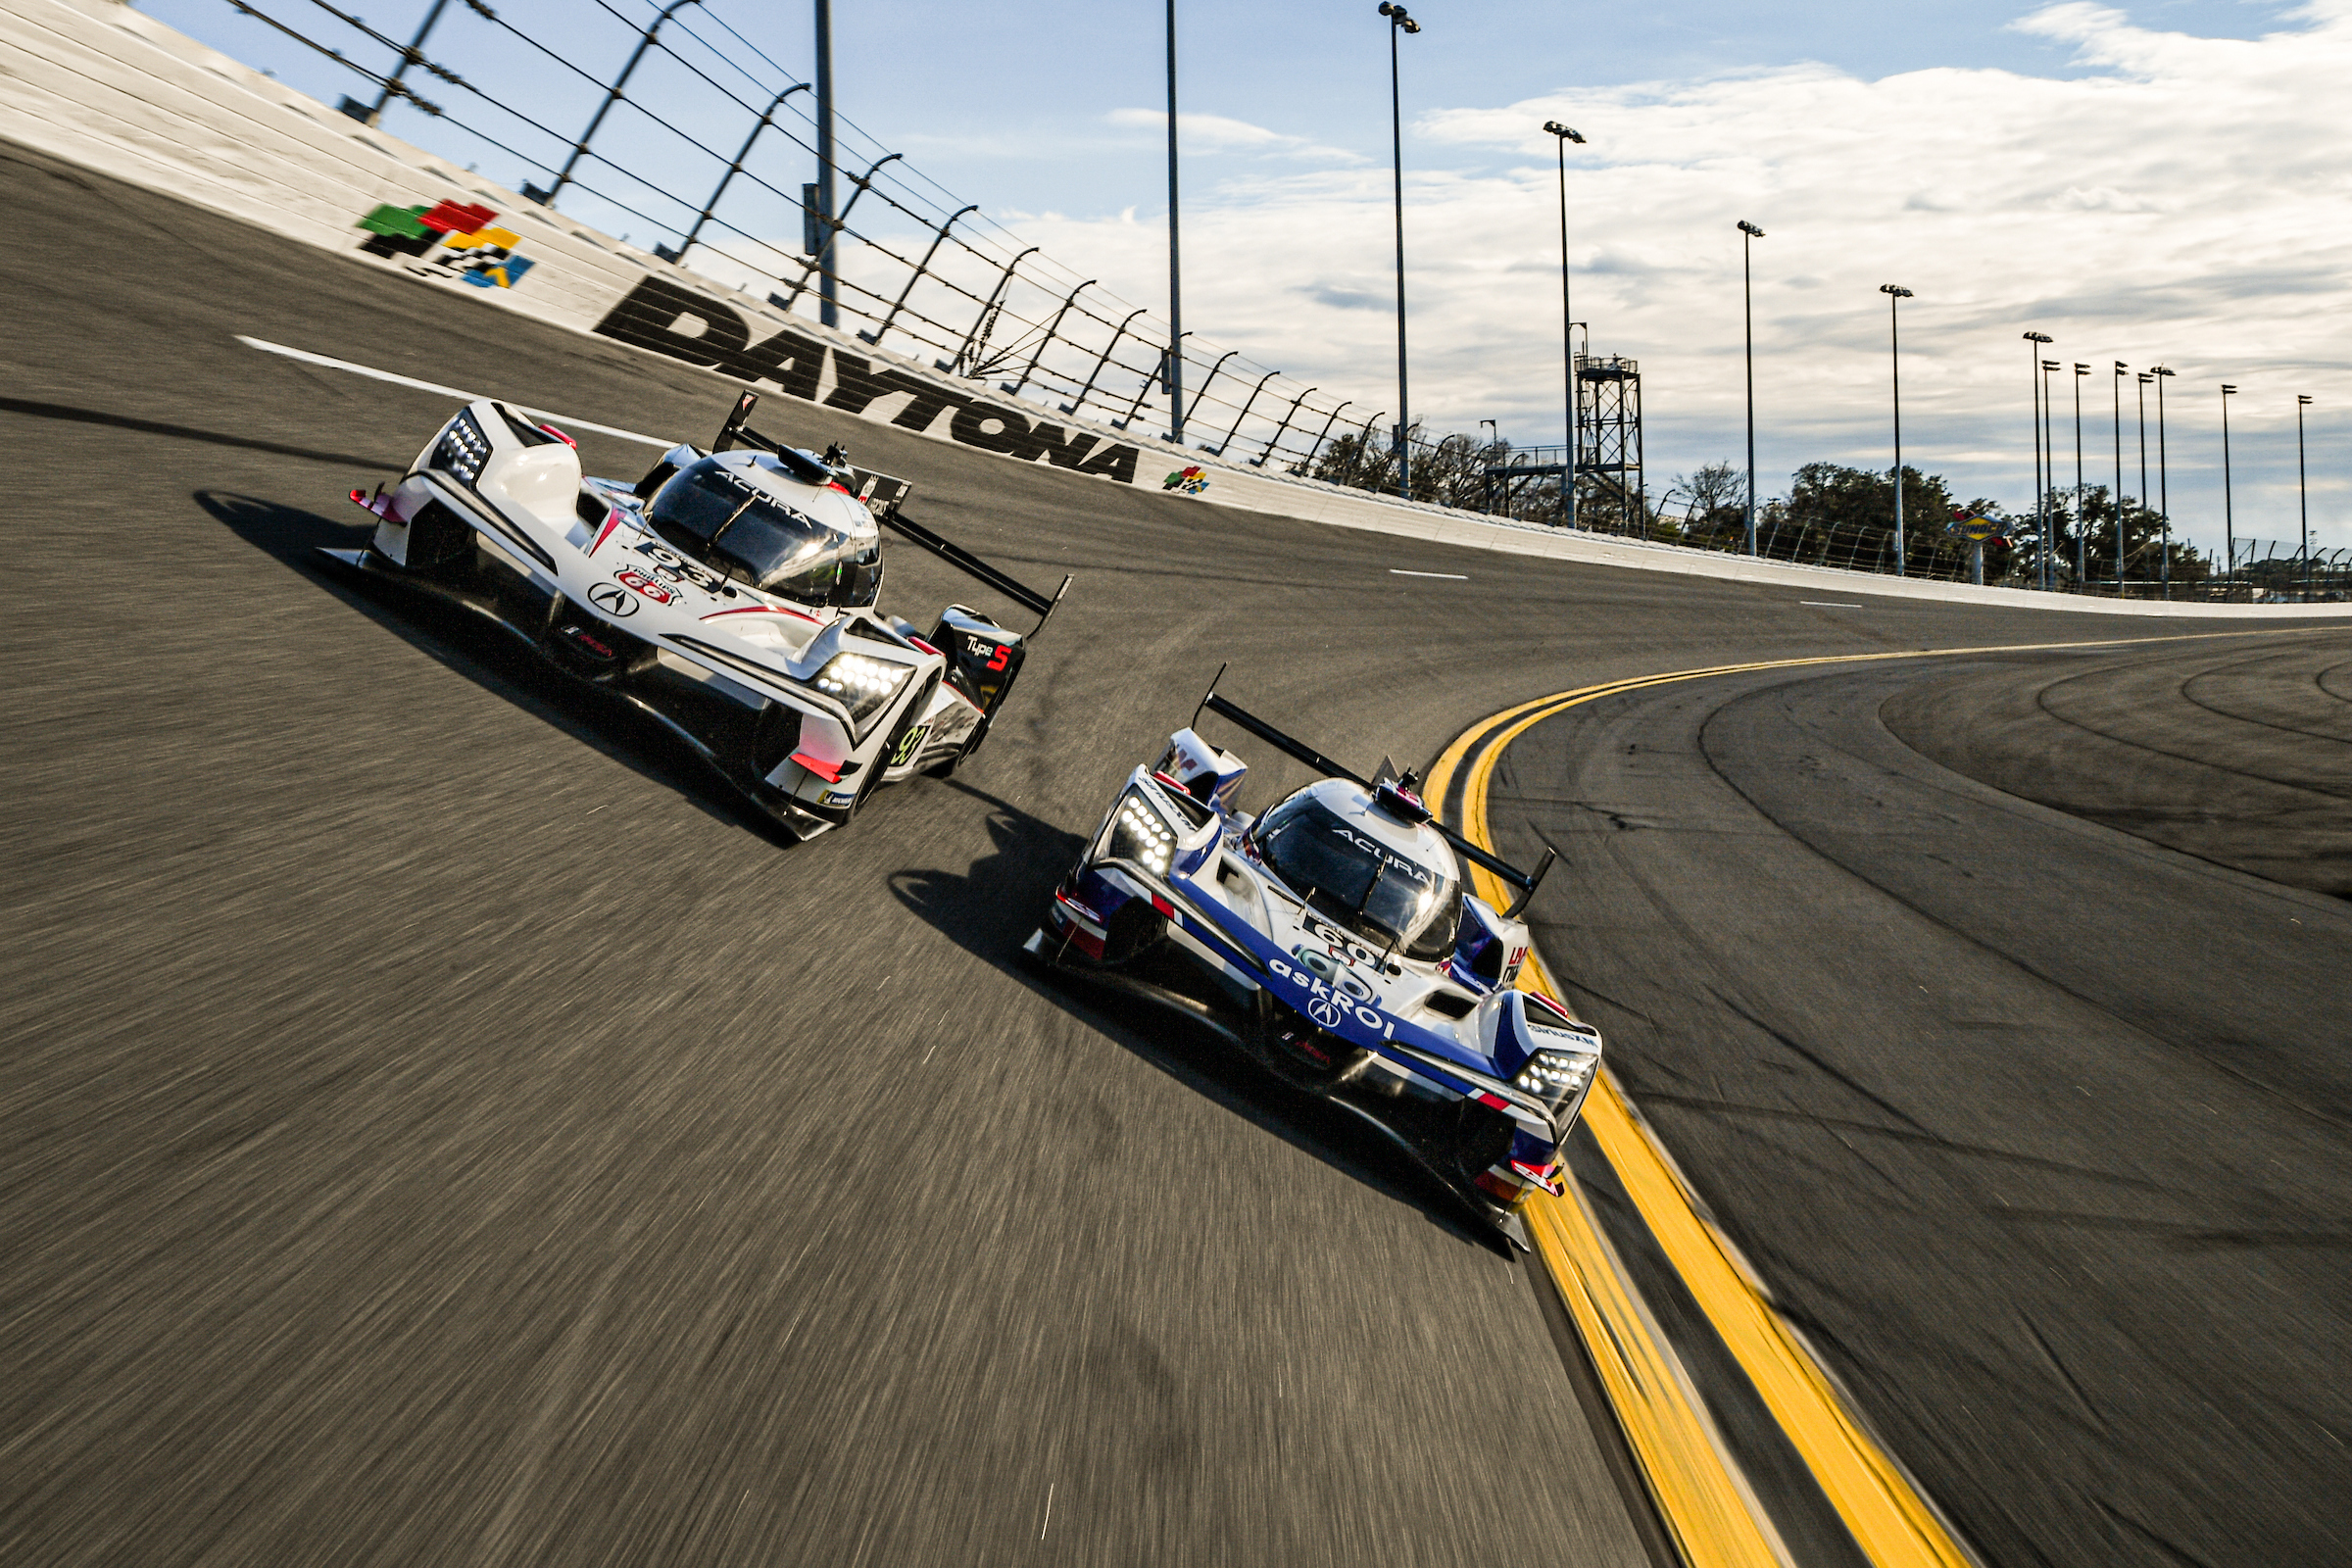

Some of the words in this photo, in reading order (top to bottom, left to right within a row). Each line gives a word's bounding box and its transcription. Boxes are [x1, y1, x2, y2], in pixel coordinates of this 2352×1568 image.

[592, 274, 1139, 484] DAYTONA
[714, 469, 812, 530] ACURA
[624, 575, 665, 599] 66
[632, 567, 675, 595] PHILLIPS
[647, 547, 713, 588] 93
[966, 634, 994, 658] Type
[986, 644, 1012, 672] S
[890, 726, 926, 764] 93
[1332, 829, 1434, 889] ACURA
[1314, 923, 1376, 966] 60
[1269, 958, 1396, 1040] askROI
